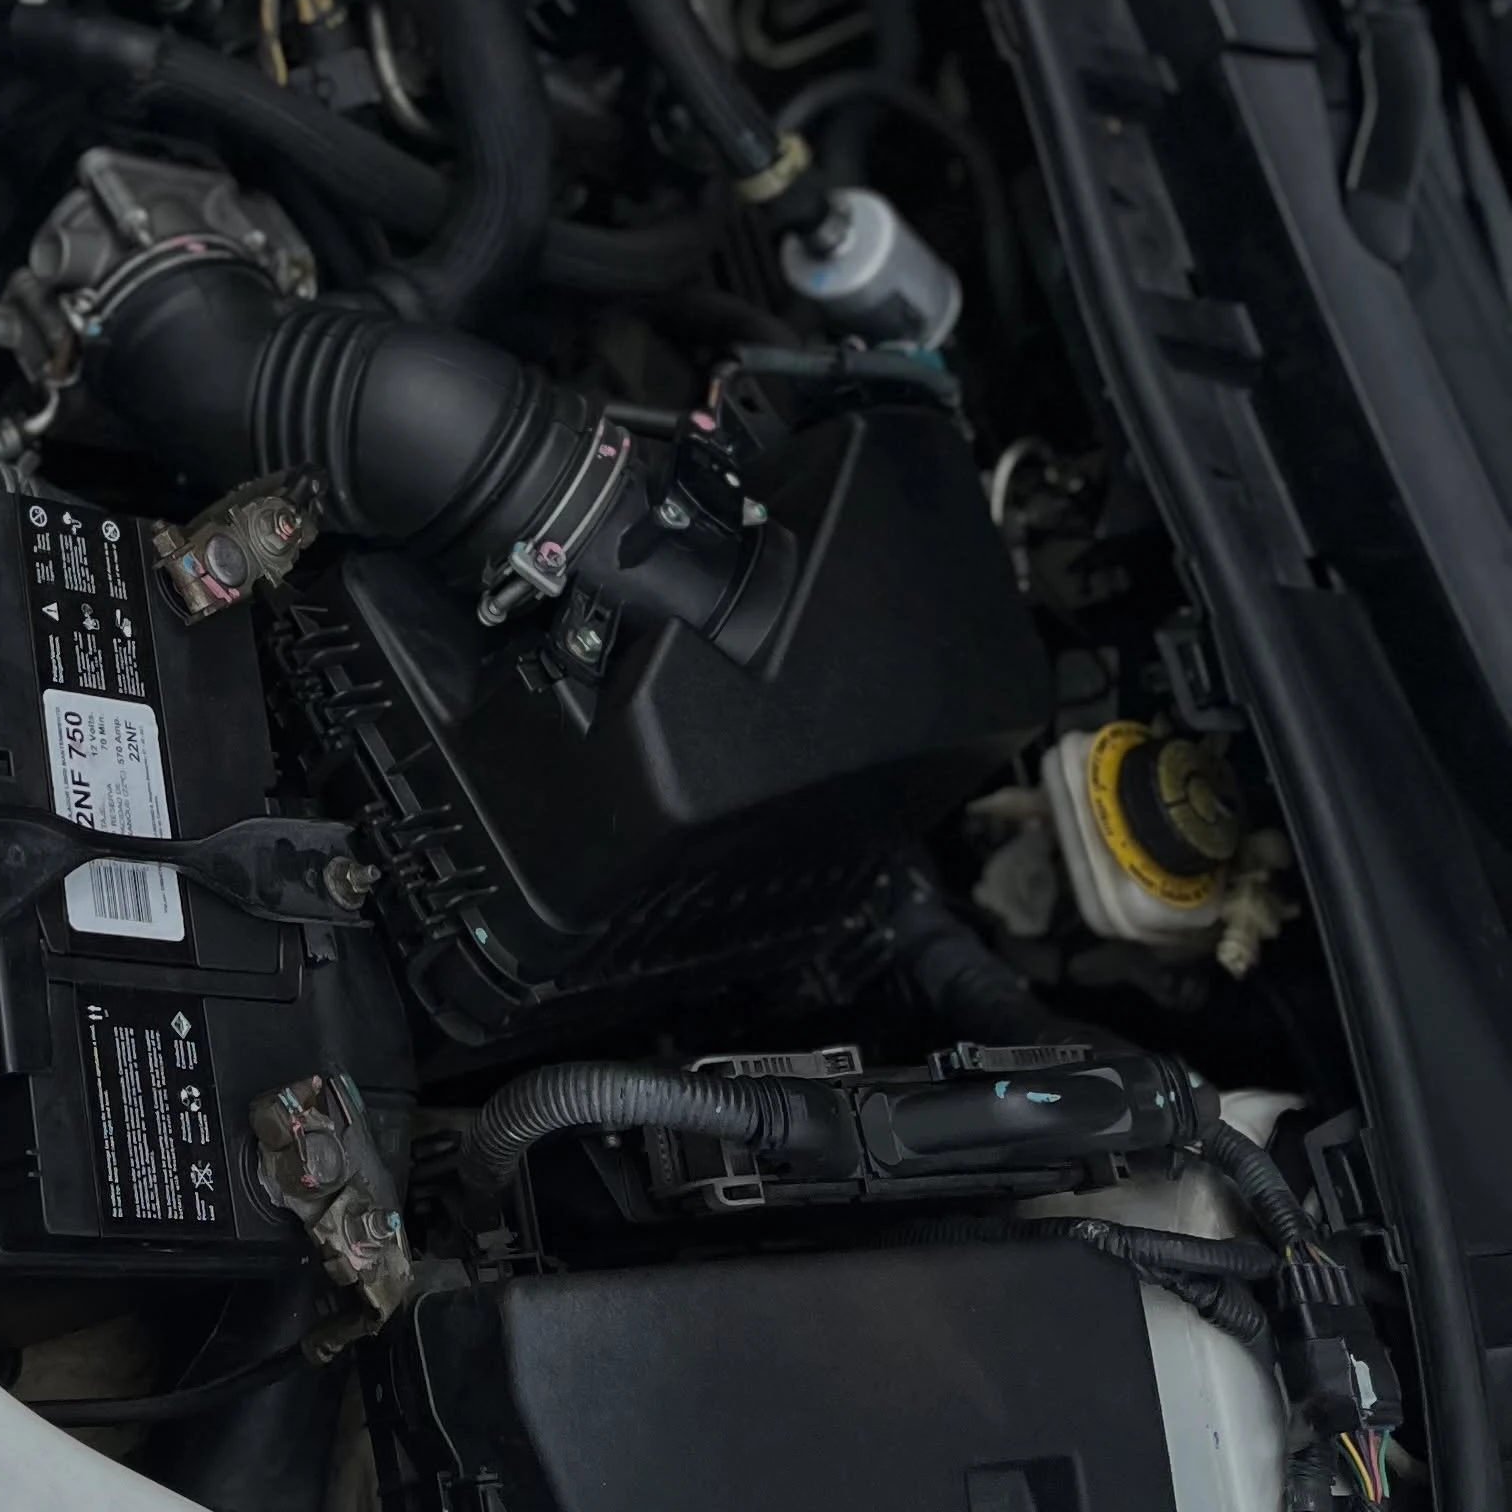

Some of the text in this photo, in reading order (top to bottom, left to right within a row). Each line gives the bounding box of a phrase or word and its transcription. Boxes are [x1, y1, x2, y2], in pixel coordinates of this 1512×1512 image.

[89, 744, 98, 756] 12
[99, 738, 108, 750] 70
[124, 720, 140, 763] 22NF
[115, 746, 125, 764] 570
[64, 711, 95, 830] 2NF 750
